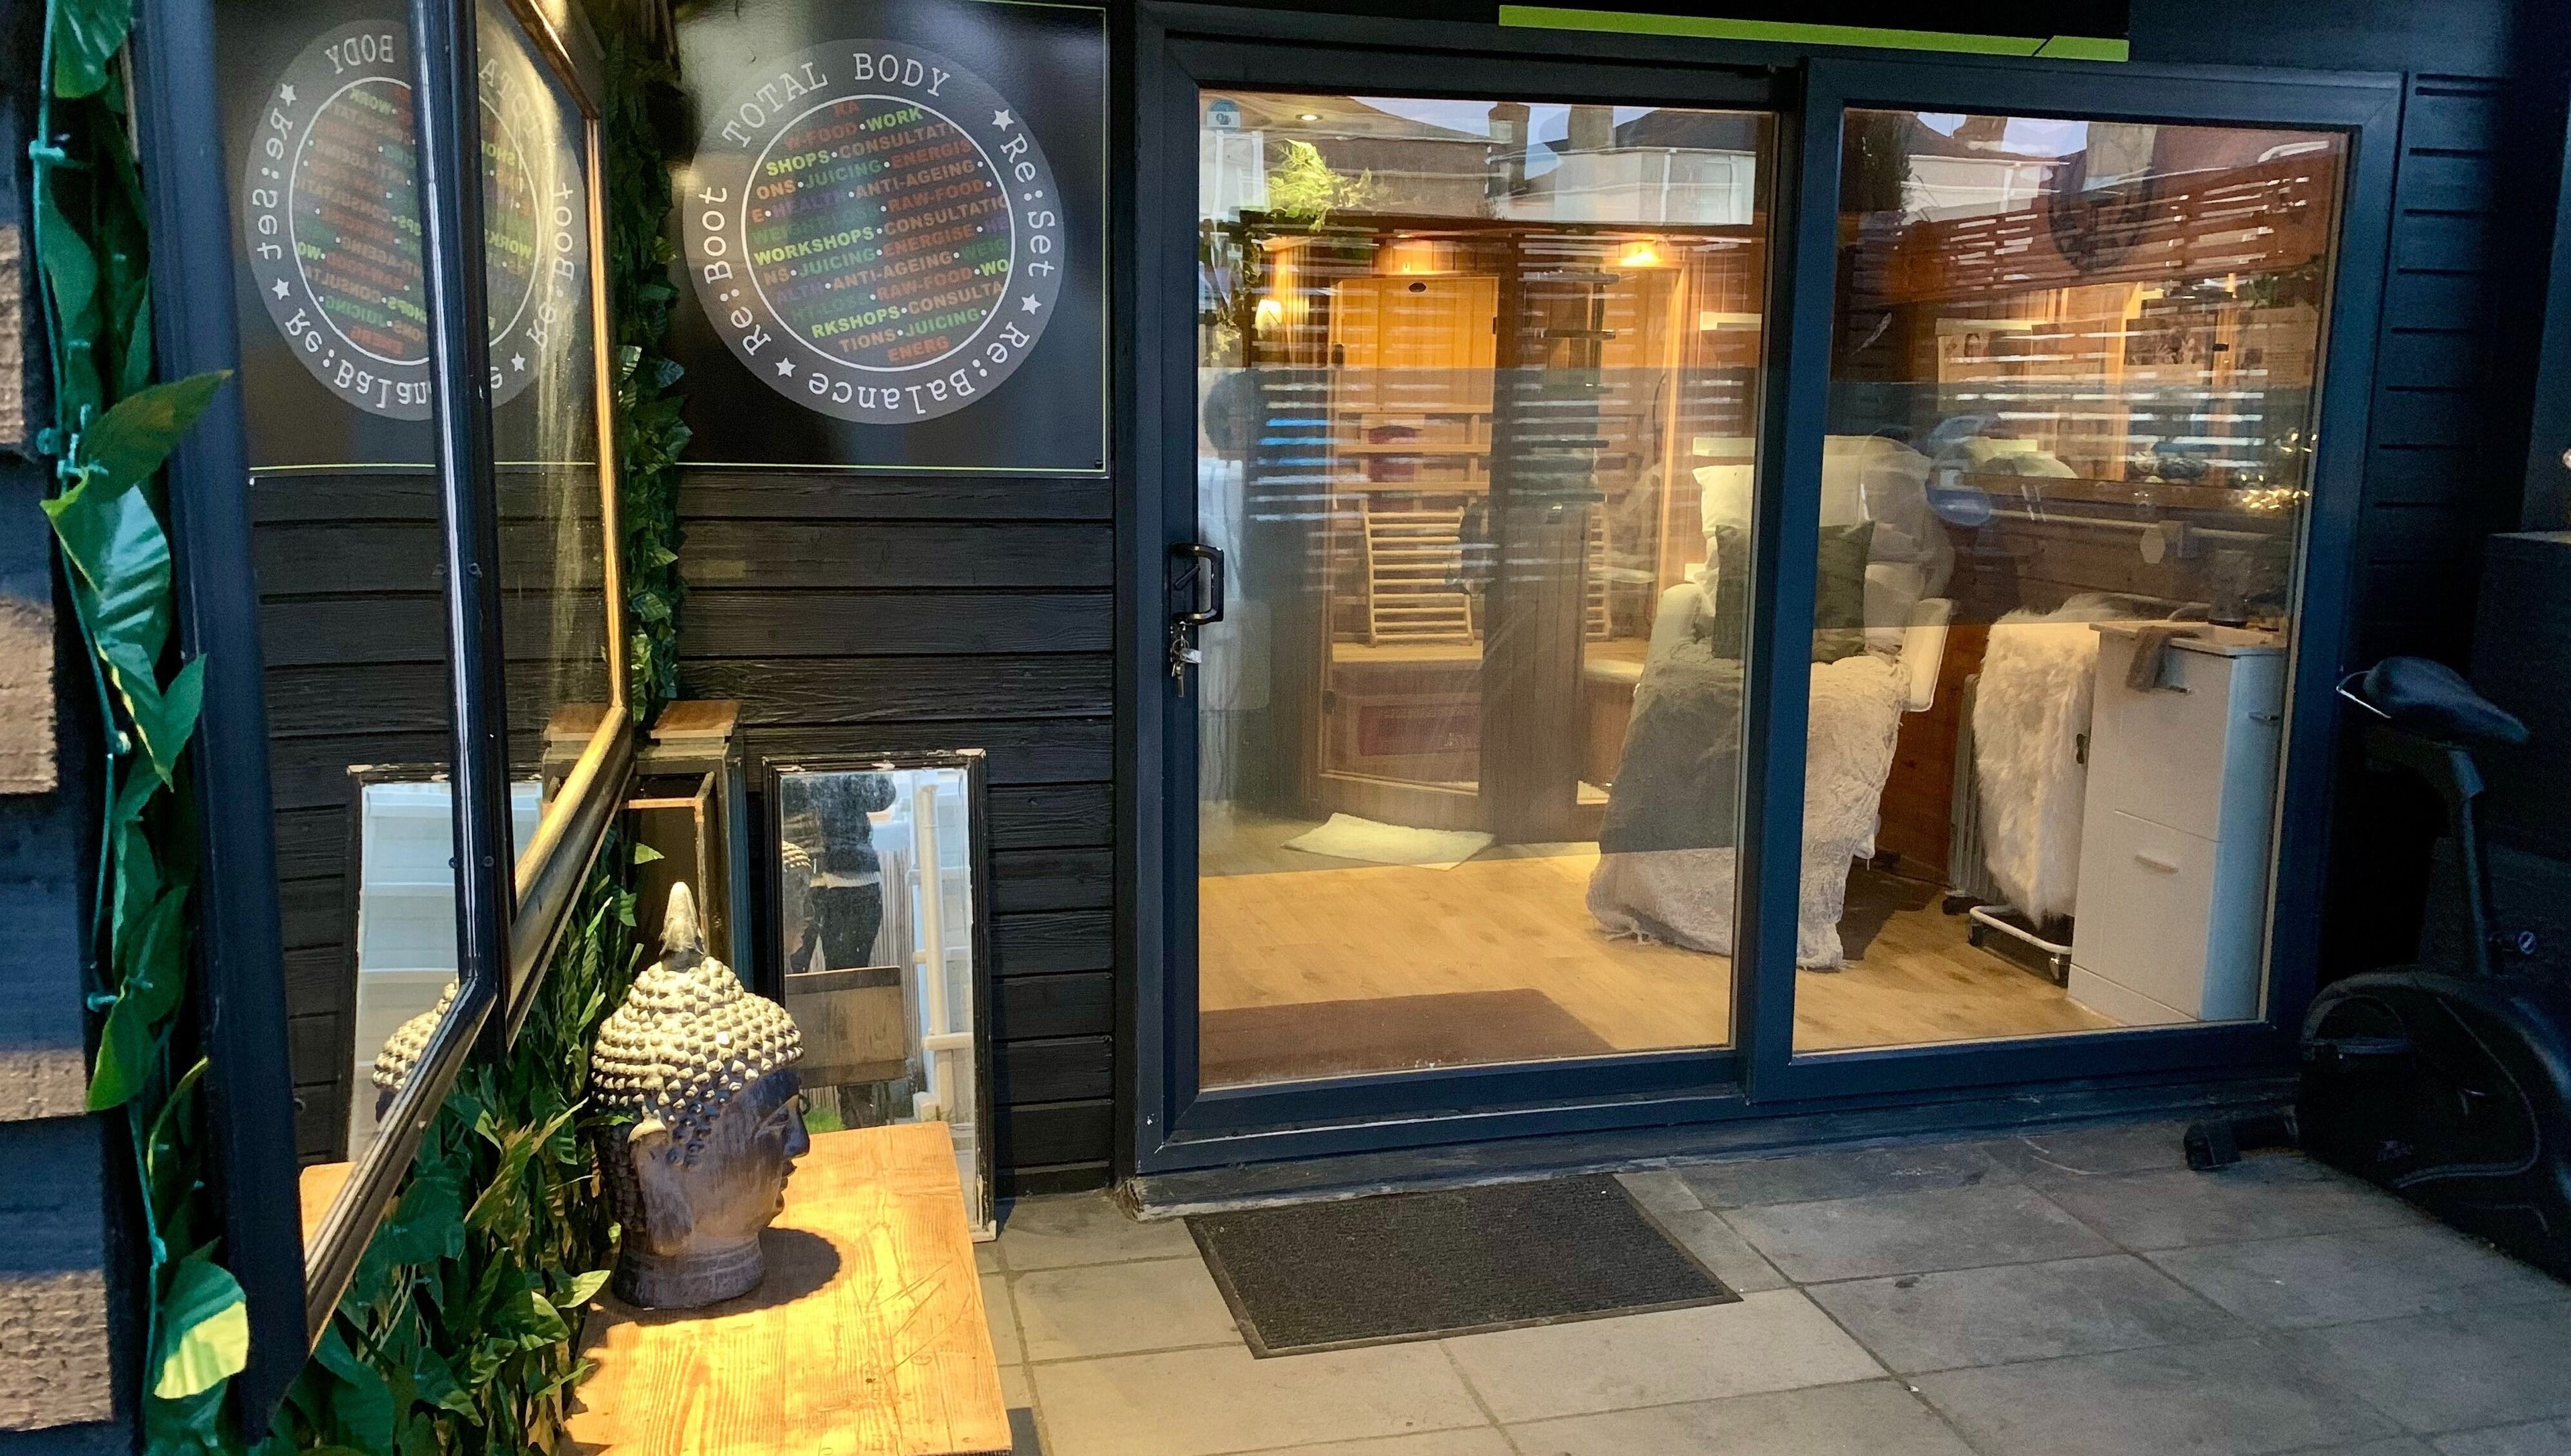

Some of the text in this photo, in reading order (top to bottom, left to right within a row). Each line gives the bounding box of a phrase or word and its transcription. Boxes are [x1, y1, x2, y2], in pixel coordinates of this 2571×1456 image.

[722, 54, 950, 147] TOTAL BODY
[866, 107, 923, 131] WORK
[757, 179, 796, 199] ONS
[805, 160, 882, 189] JUICING
[766, 149, 830, 175] SHOPS
[754, 226, 874, 266] WORKSHOPS
[800, 248, 876, 277] JUICING
[834, 251, 952, 290] ANTI-AGEING
[980, 259, 1010, 276] WO
[811, 280, 1003, 338] RKSHOPS CONSULTA
[839, 309, 980, 351] TIONS JUICING
